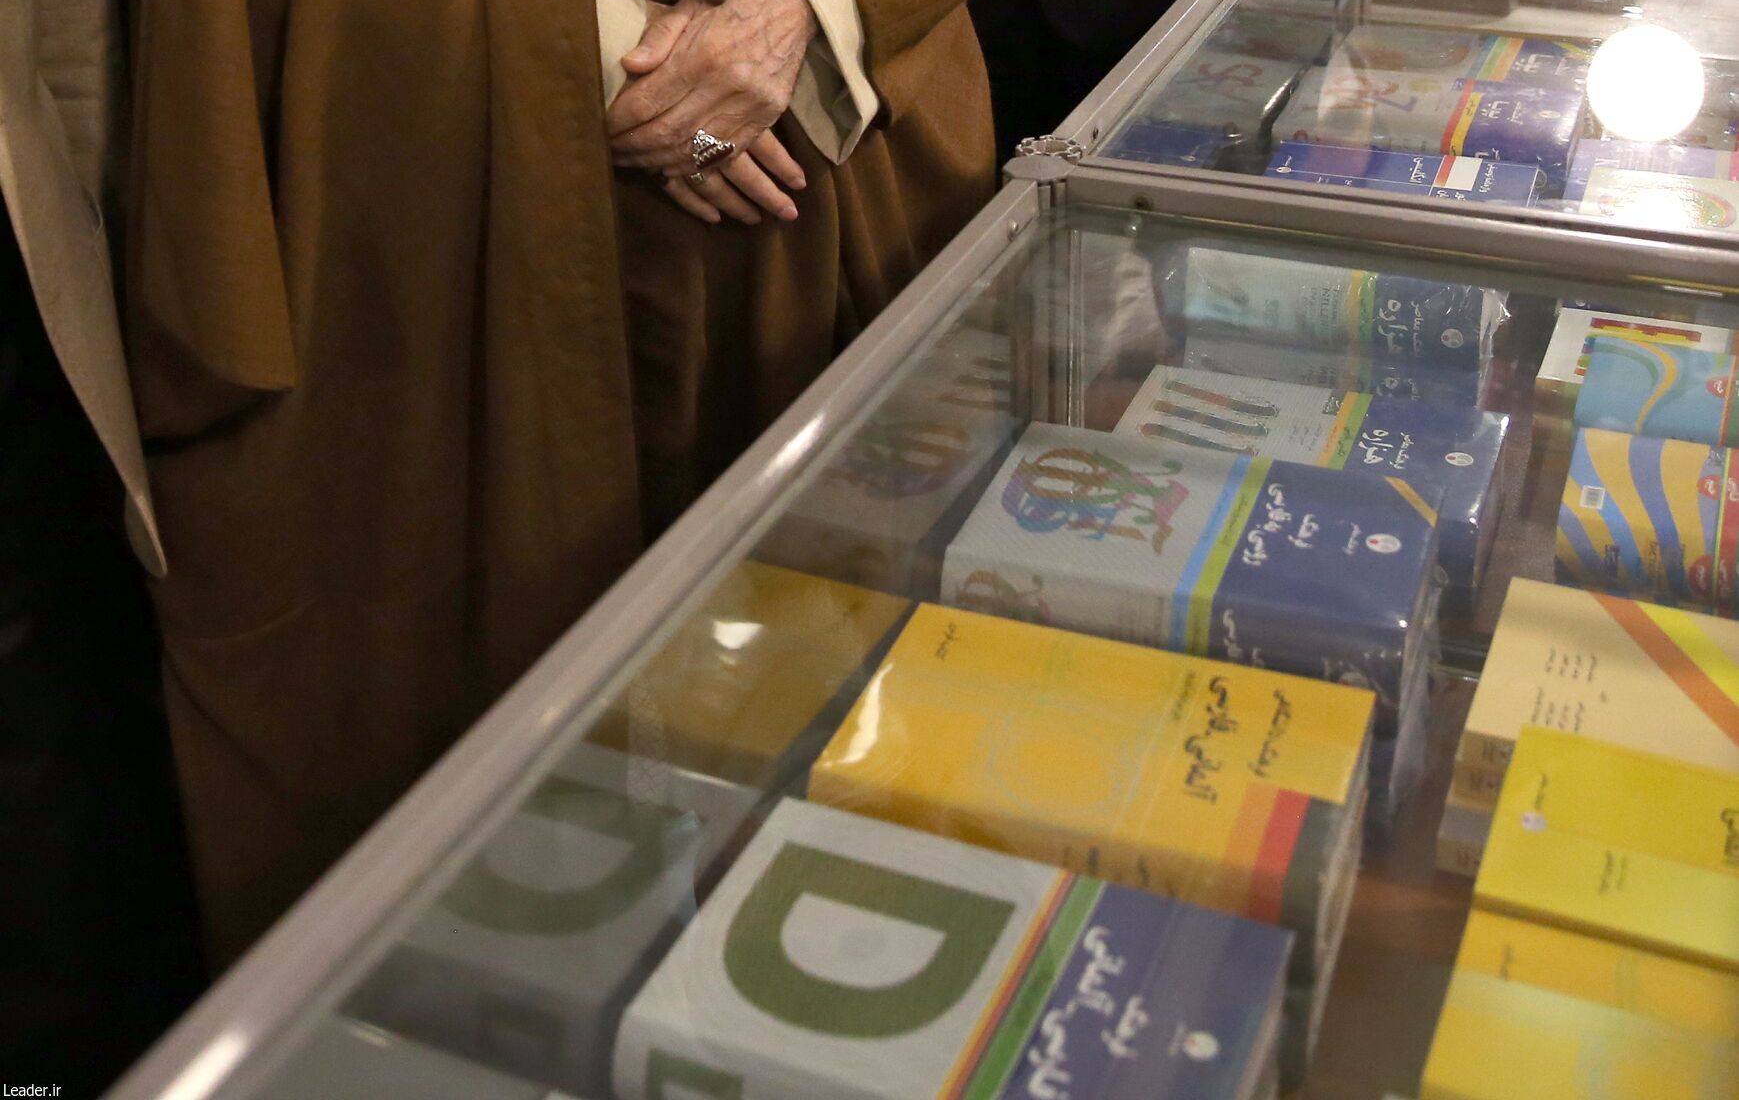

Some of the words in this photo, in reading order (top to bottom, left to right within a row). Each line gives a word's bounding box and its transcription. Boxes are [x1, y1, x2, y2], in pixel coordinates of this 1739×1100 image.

[1408, 156, 1428, 184] انگلیسی
[1358, 429, 1394, 465] هزاره
[722, 840, 1017, 1040] D
